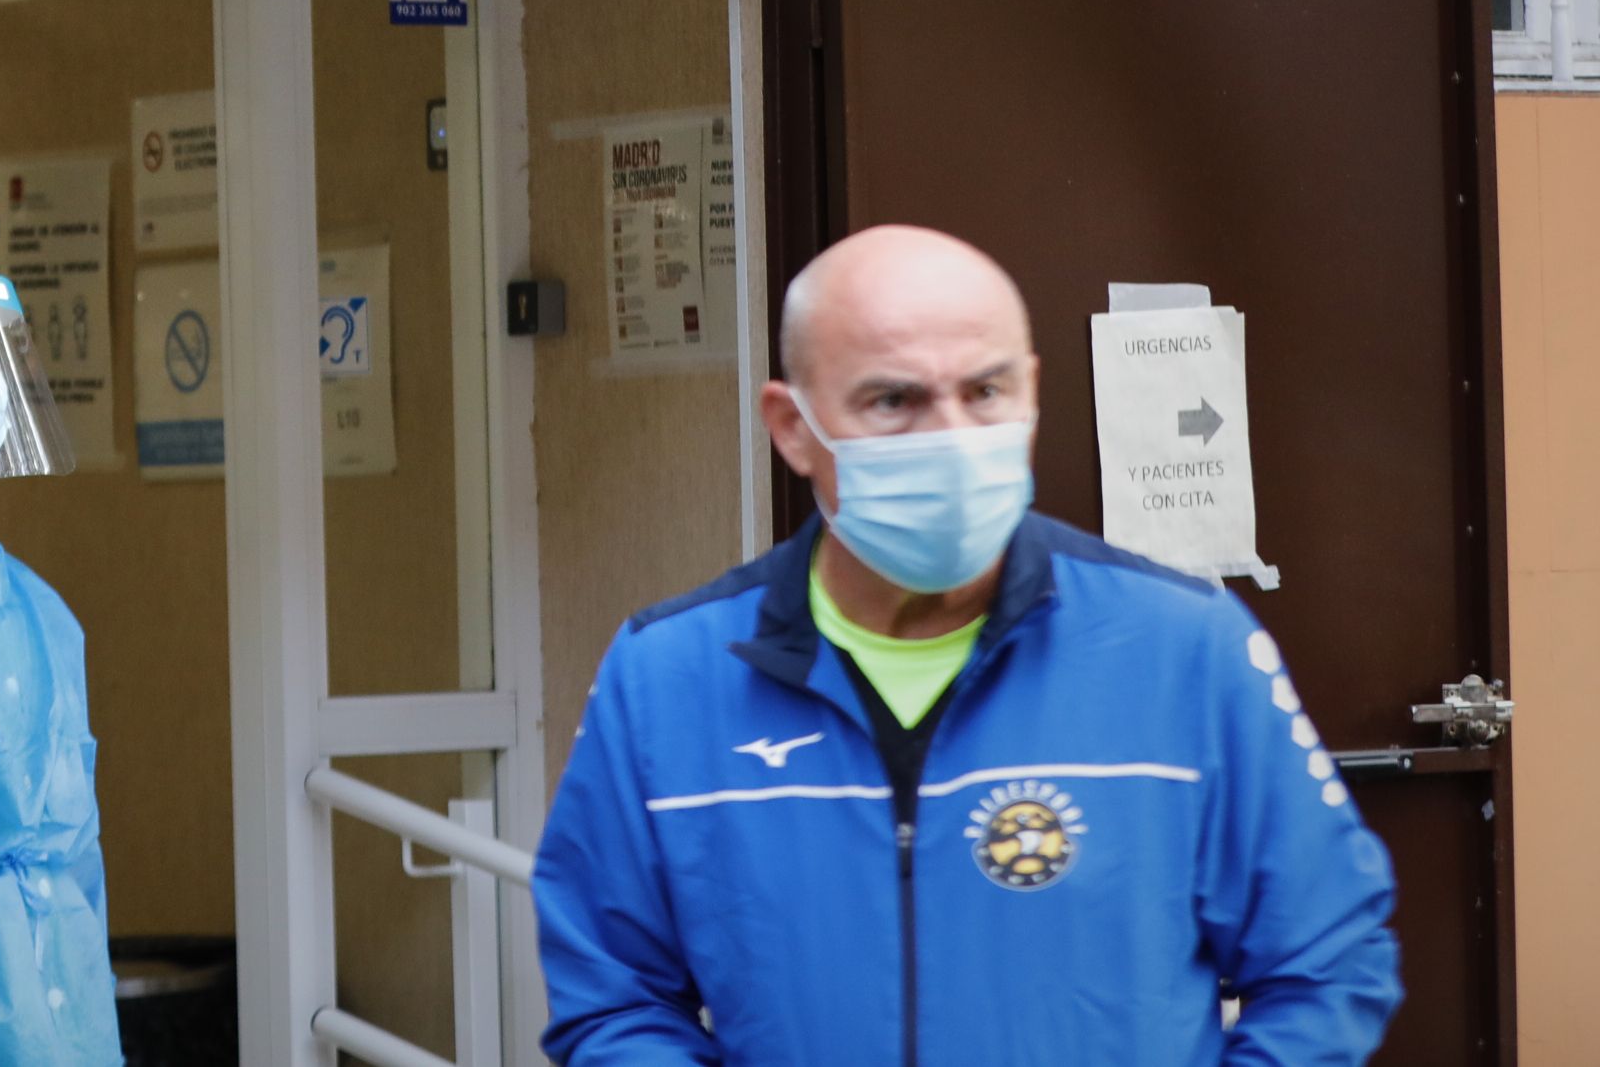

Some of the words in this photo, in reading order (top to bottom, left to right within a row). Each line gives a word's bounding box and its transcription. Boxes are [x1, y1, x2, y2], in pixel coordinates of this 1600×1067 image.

[396, 5, 416, 16] 902
[1125, 335, 1212, 356] URGENCIAS
[1128, 467, 1138, 482] Y
[1142, 461, 1225, 481] PACIENTES
[1142, 494, 1175, 511] CON
[1179, 491, 1215, 507] CITA
